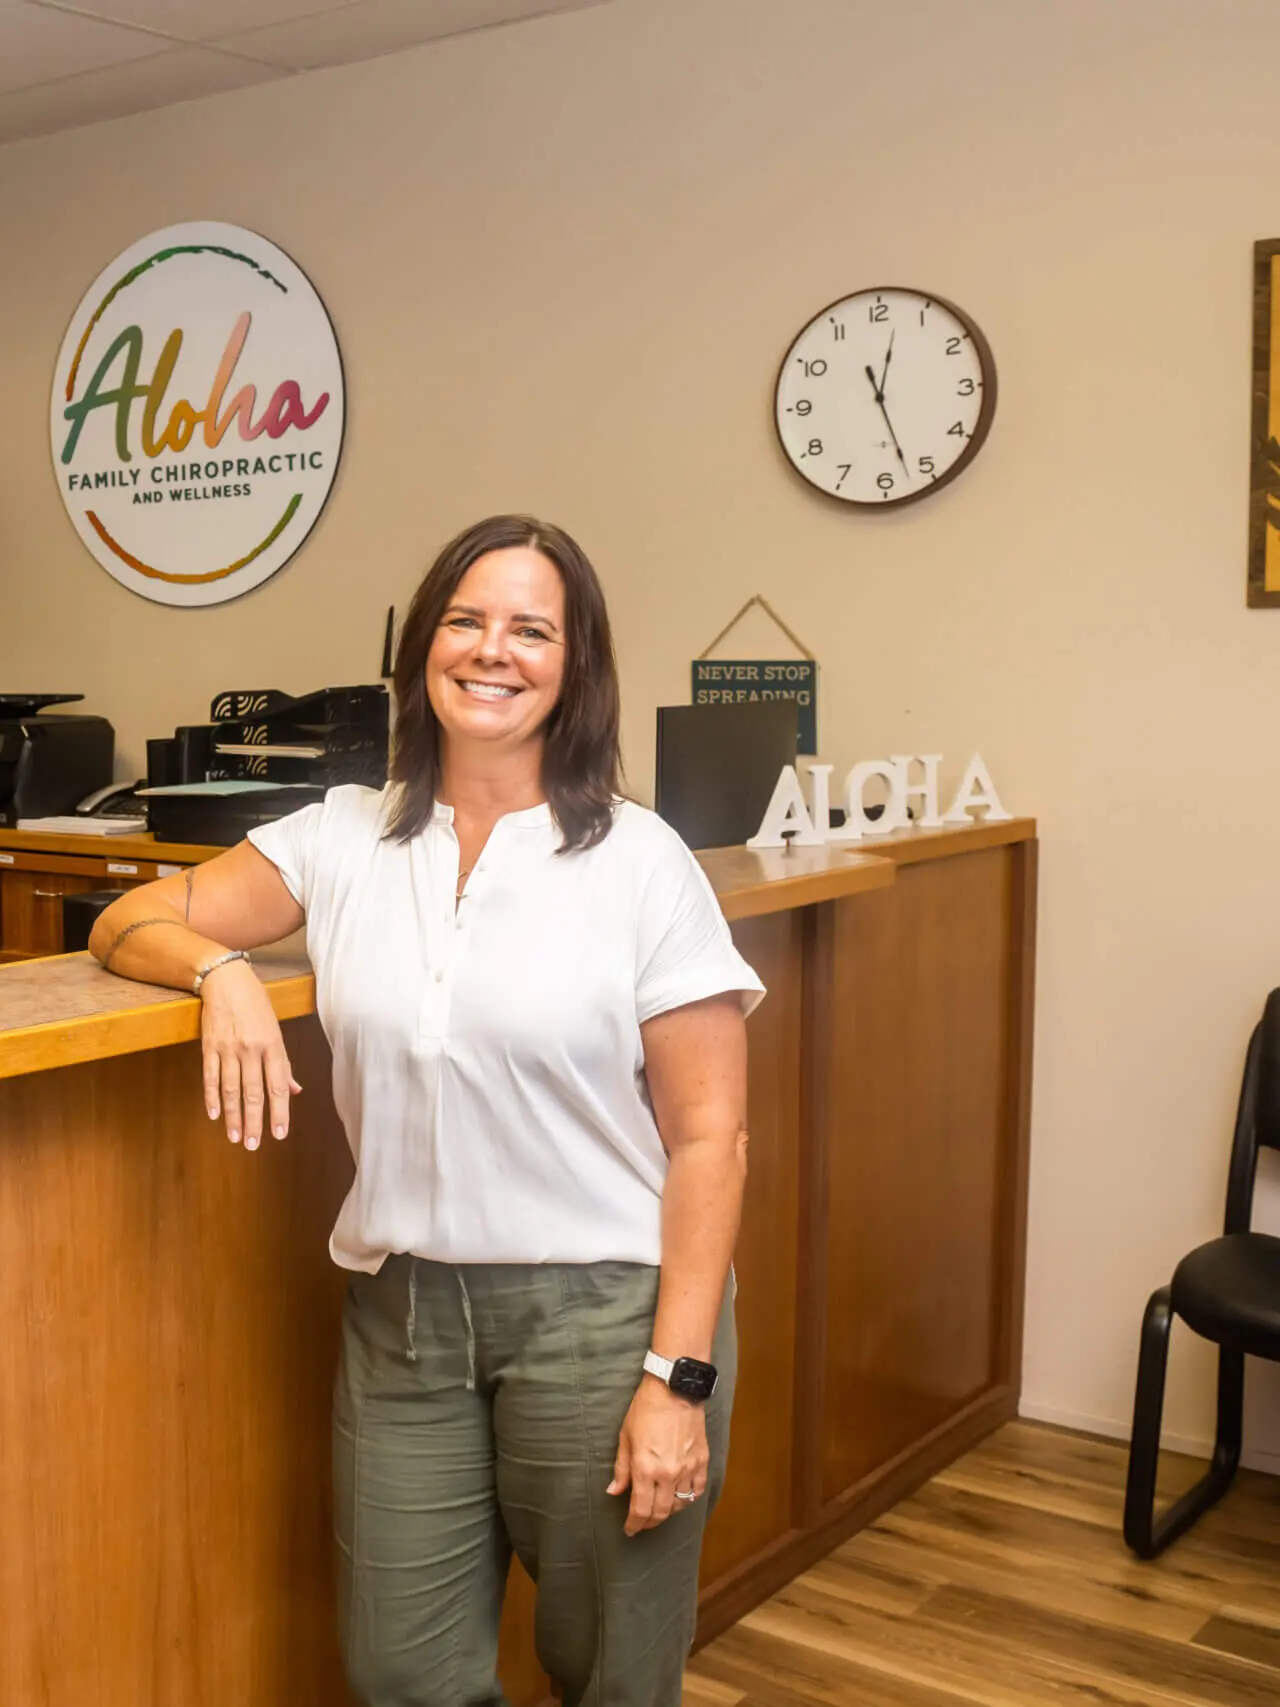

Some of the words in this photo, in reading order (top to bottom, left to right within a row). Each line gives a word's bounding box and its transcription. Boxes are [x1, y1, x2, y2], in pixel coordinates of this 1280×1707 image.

[869, 304, 889, 323] 12
[920, 309, 924, 327] 1
[834, 323, 845, 341] 11
[946, 337, 961, 355] 2
[804, 359, 827, 377] 10
[61, 311, 330, 464] Aloha
[957, 378, 975, 396] 3
[795, 400, 812, 416] 9
[946, 421, 964, 438] 4
[808, 439, 823, 456] 8
[68, 468, 141, 491] FAMILY
[151, 451, 324, 484] CHIROPRACTIC
[836, 464, 852, 481] 7
[919, 456, 935, 474] 5
[876, 472, 894, 490] 6
[132, 489, 163, 504] AND
[169, 483, 252, 502] WELLNESS
[697, 665, 759, 680] NEVER
[764, 665, 811, 681] STOP
[745, 751, 1014, 848] ALOHA
